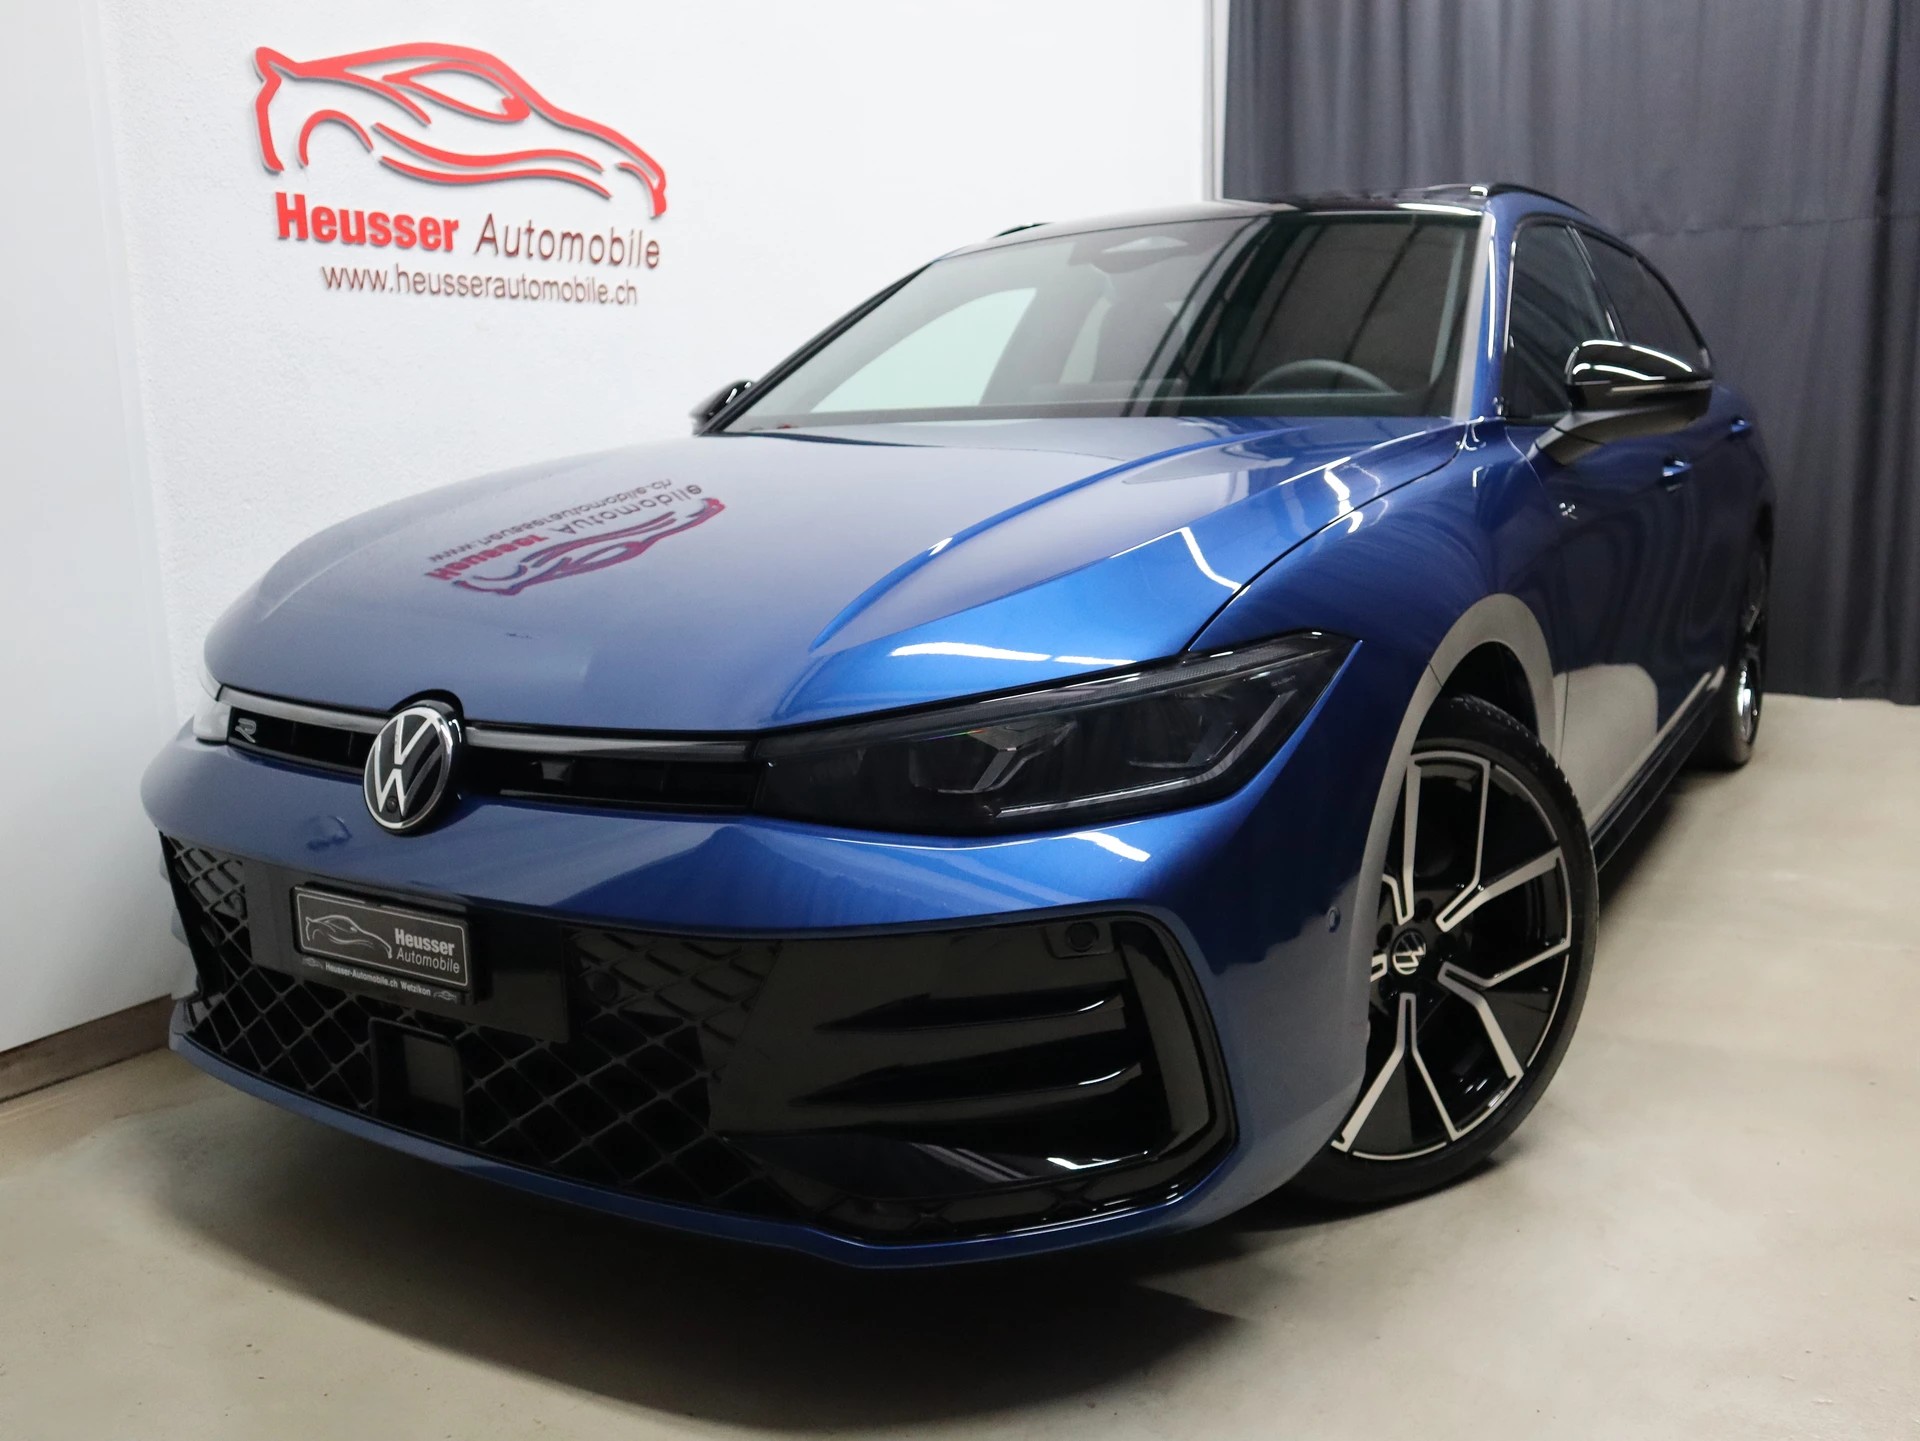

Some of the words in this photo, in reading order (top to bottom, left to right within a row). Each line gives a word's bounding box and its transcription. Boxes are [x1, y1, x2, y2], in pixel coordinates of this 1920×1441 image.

[274, 191, 459, 253] Heusser
[474, 212, 660, 269] Automobile
[321, 263, 638, 305] www.heusserautomobile.ch
[394, 928, 455, 956] Heusser
[396, 948, 460, 974] Automobile
[325, 962, 398, 988] Heusser-Automobile.ch
[400, 981, 431, 996] Wetzikon
